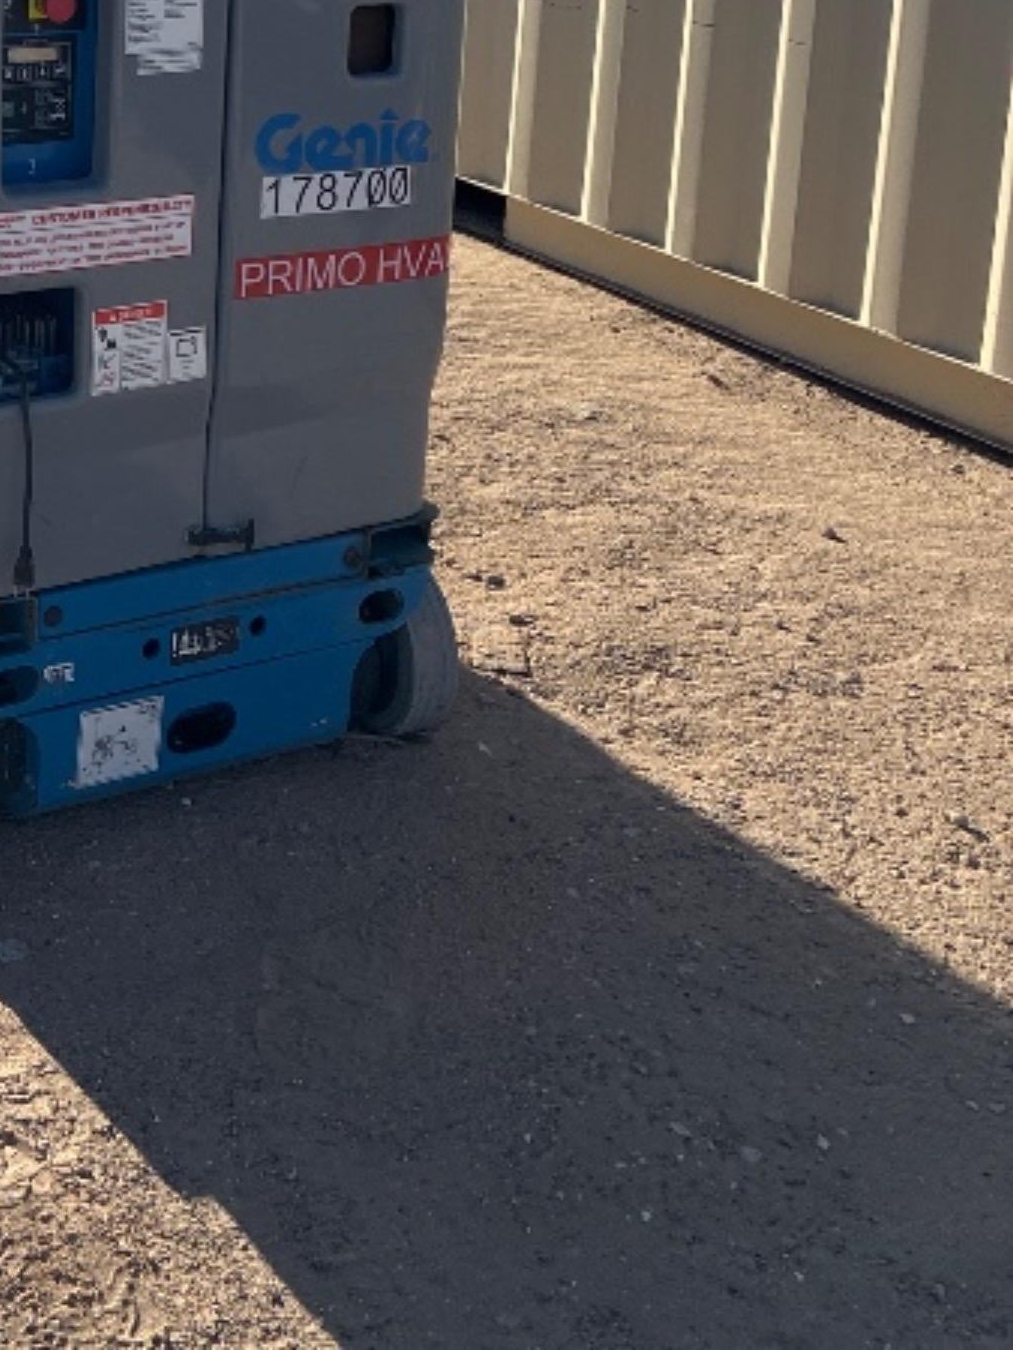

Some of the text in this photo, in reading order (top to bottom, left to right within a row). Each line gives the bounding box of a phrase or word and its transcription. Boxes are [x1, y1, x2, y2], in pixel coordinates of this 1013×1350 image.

[255, 107, 431, 174] Genie
[265, 167, 409, 214] 178700
[240, 251, 367, 298] PRIMO
